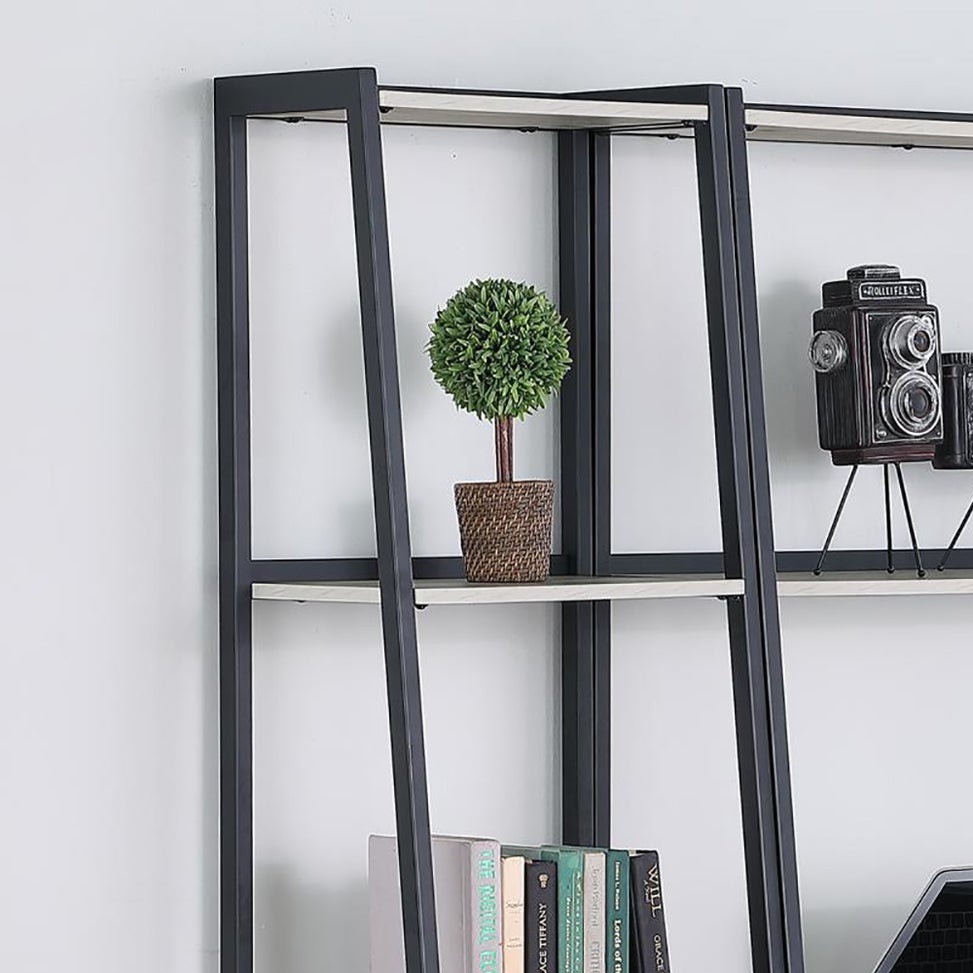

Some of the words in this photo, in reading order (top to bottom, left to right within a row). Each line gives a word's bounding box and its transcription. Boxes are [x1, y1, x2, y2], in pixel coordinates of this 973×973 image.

[478, 849, 496, 880] THE
[647, 863, 662, 918] WILL
[538, 902, 548, 949] TIFFANY
[614, 919, 622, 948] Lords
[613, 950, 622, 963] of
[653, 934, 664, 972] GRACE
